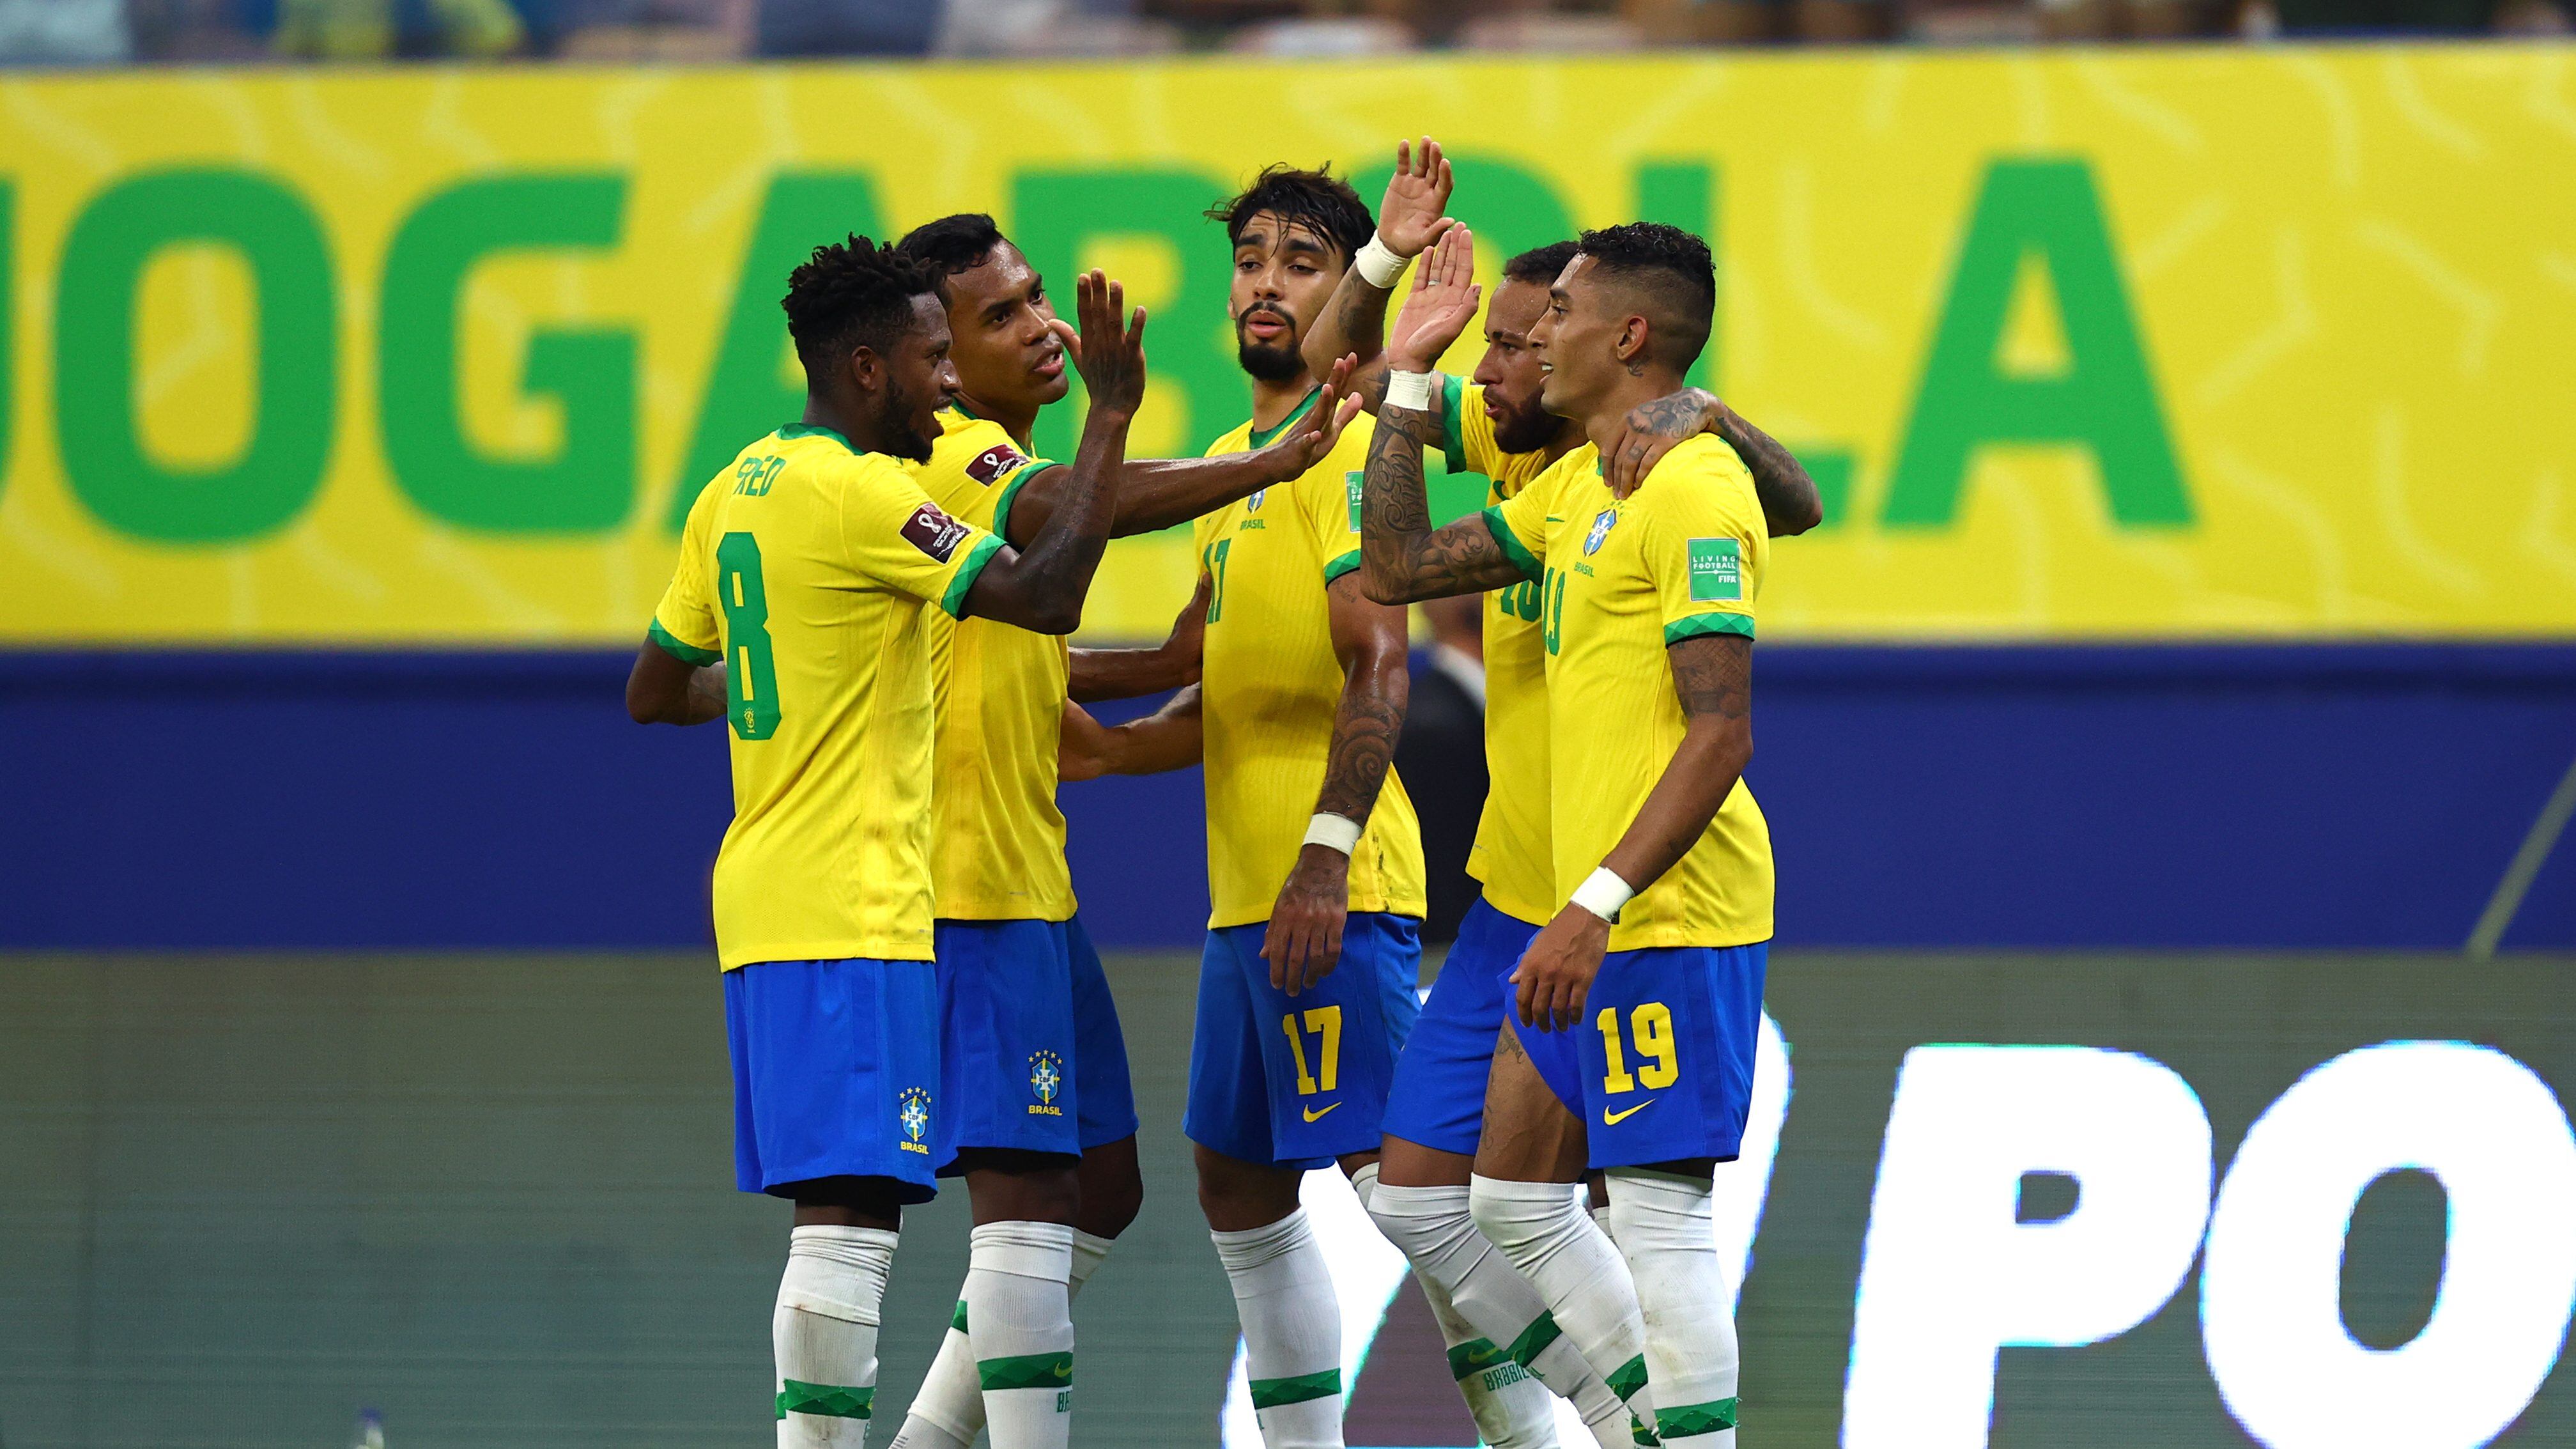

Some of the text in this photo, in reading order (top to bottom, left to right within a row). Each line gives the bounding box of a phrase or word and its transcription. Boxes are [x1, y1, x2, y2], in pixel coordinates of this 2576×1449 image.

[0, 157, 2198, 546] OGABA
[716, 532, 782, 740] 8
[1282, 1005, 1342, 1096] 17
[1596, 1002, 1679, 1094] 19
[900, 1141, 929, 1155] BRASIL
[1028, 1104, 1063, 1116] BRASIL
